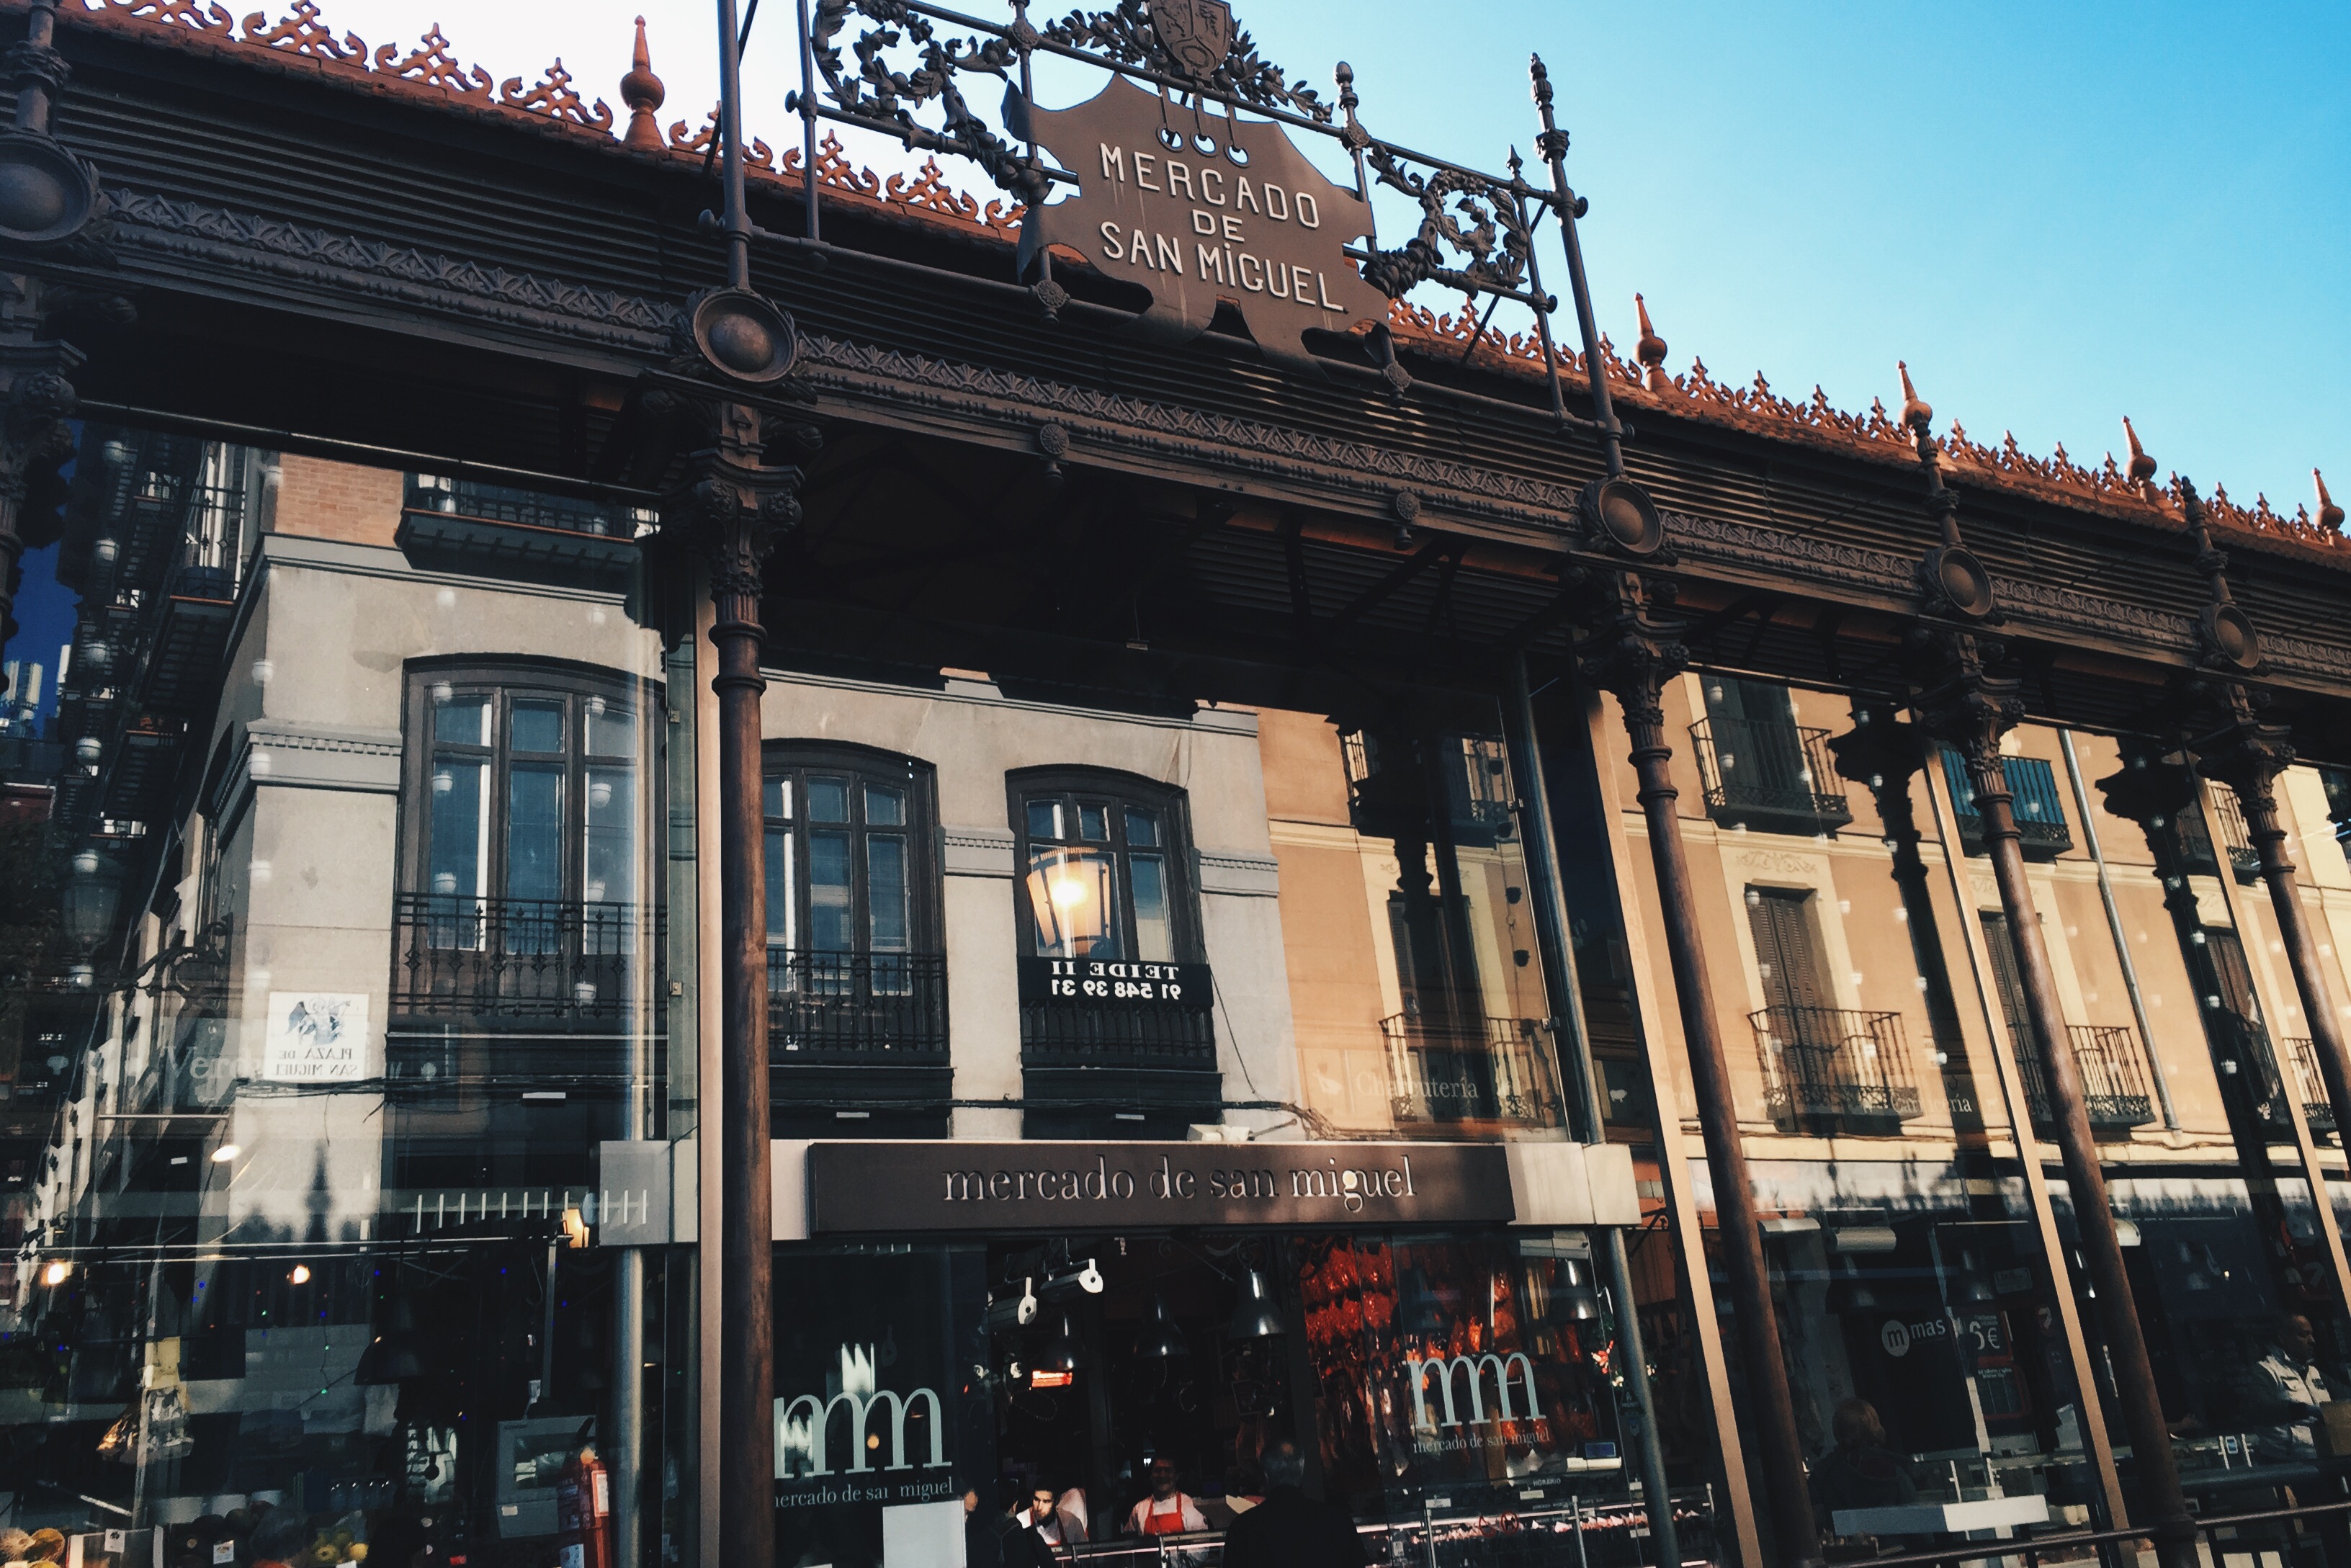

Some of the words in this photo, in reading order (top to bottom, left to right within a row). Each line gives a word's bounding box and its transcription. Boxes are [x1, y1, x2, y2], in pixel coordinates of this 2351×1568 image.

[1100, 143, 1320, 228] MERCADO
[1193, 208, 1245, 243] DE
[1100, 221, 1183, 274] SAN
[941, 1154, 1136, 1201] mercado
[1150, 1154, 1196, 1200] de
[1209, 1168, 1280, 1199] san
[1289, 1154, 1418, 1214] miguel
[1910, 1319, 1945, 1340] mas
[1412, 1433, 1467, 1453] mercado
[1469, 1433, 1484, 1448] de
[1510, 1426, 1551, 1448] miguel
[842, 1484, 861, 1502] de
[900, 1477, 954, 1502] miguel
